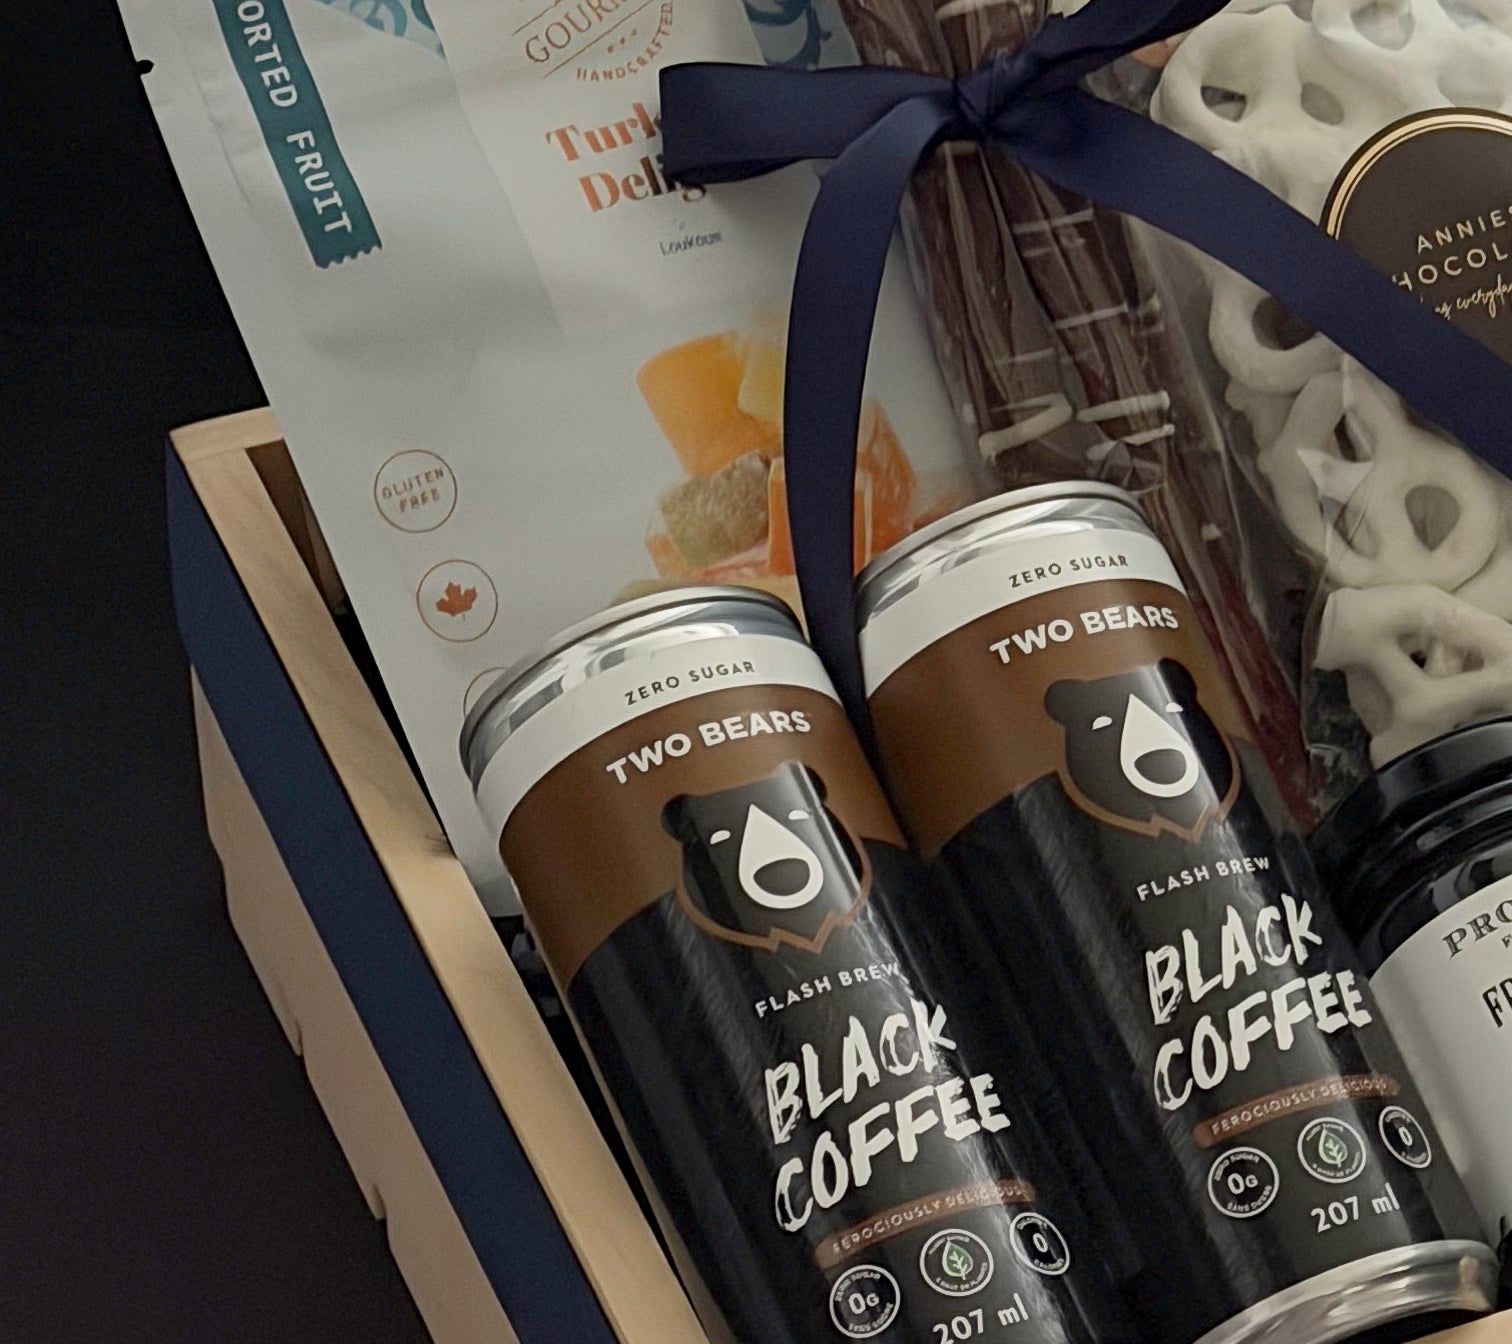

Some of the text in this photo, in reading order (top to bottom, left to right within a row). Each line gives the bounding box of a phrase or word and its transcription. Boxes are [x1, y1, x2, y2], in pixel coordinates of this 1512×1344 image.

[576, 0, 674, 82] HANDCRAFTED
[545, 102, 661, 162] Turk
[286, 130, 352, 233] FRUIT
[381, 467, 445, 499] GLUTEN
[398, 489, 441, 513] FREE
[1008, 554, 1129, 588] ZERO SUGAR
[989, 606, 1179, 665] TWO BEARS
[624, 660, 756, 706] ZERO SUGAR
[606, 710, 811, 785] TWO BEARS
[1136, 857, 1270, 901] FLASH BREW
[1145, 893, 1323, 1025] BLACK
[754, 960, 905, 1018] FLASH BREW
[1153, 970, 1372, 1111] COFFEE
[765, 996, 957, 1145] BLACK
[1210, 1088, 1317, 1136] FEROCIOUSLY
[775, 1073, 1011, 1232] COFFEE
[832, 1200, 940, 1254] FEROCIOUSLY
[1311, 1182, 1399, 1233] 207 ml
[998, 1293, 1029, 1327] ml
